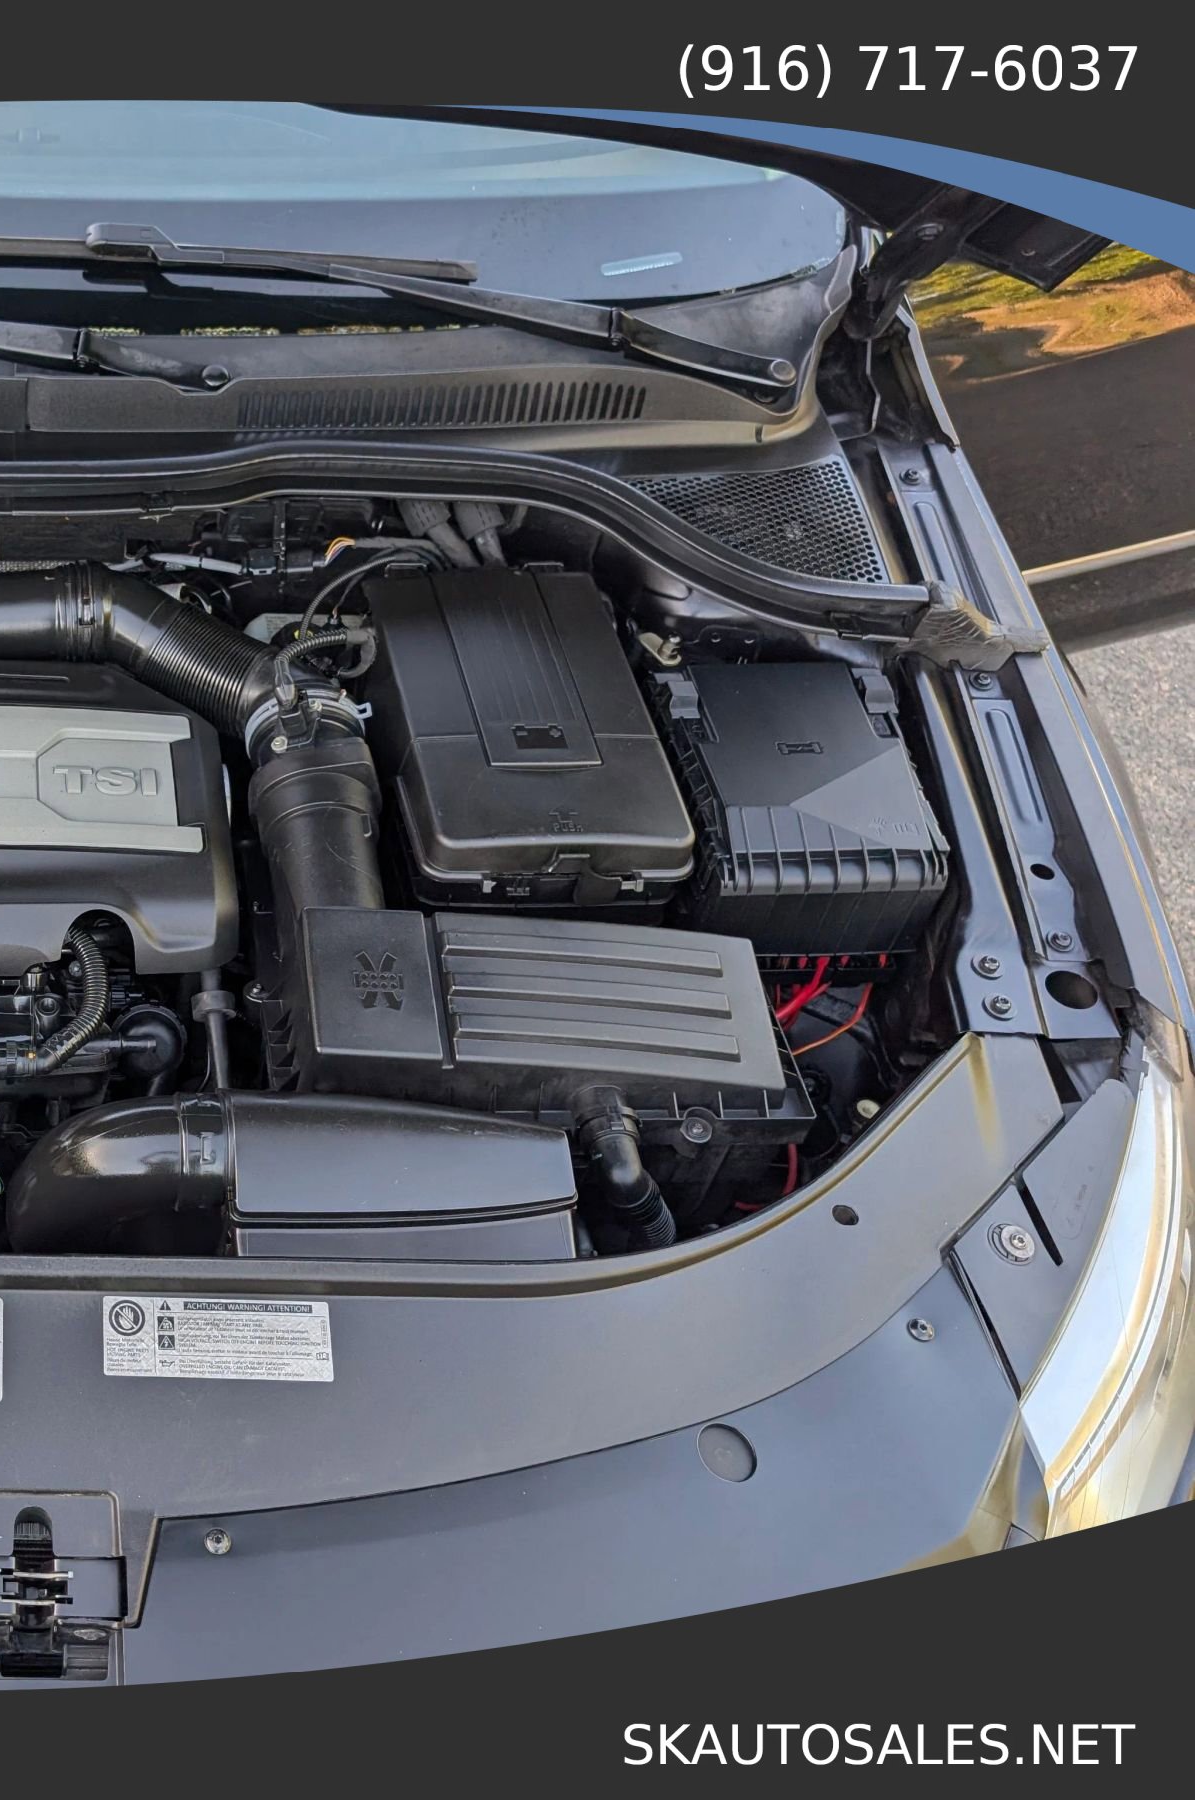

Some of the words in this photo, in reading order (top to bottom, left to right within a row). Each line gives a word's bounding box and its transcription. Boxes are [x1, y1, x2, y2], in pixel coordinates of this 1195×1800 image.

[53, 766, 158, 796] TSI
[227, 1303, 266, 1311] WARNING!
[267, 1305, 310, 1313] ATTENTION!
